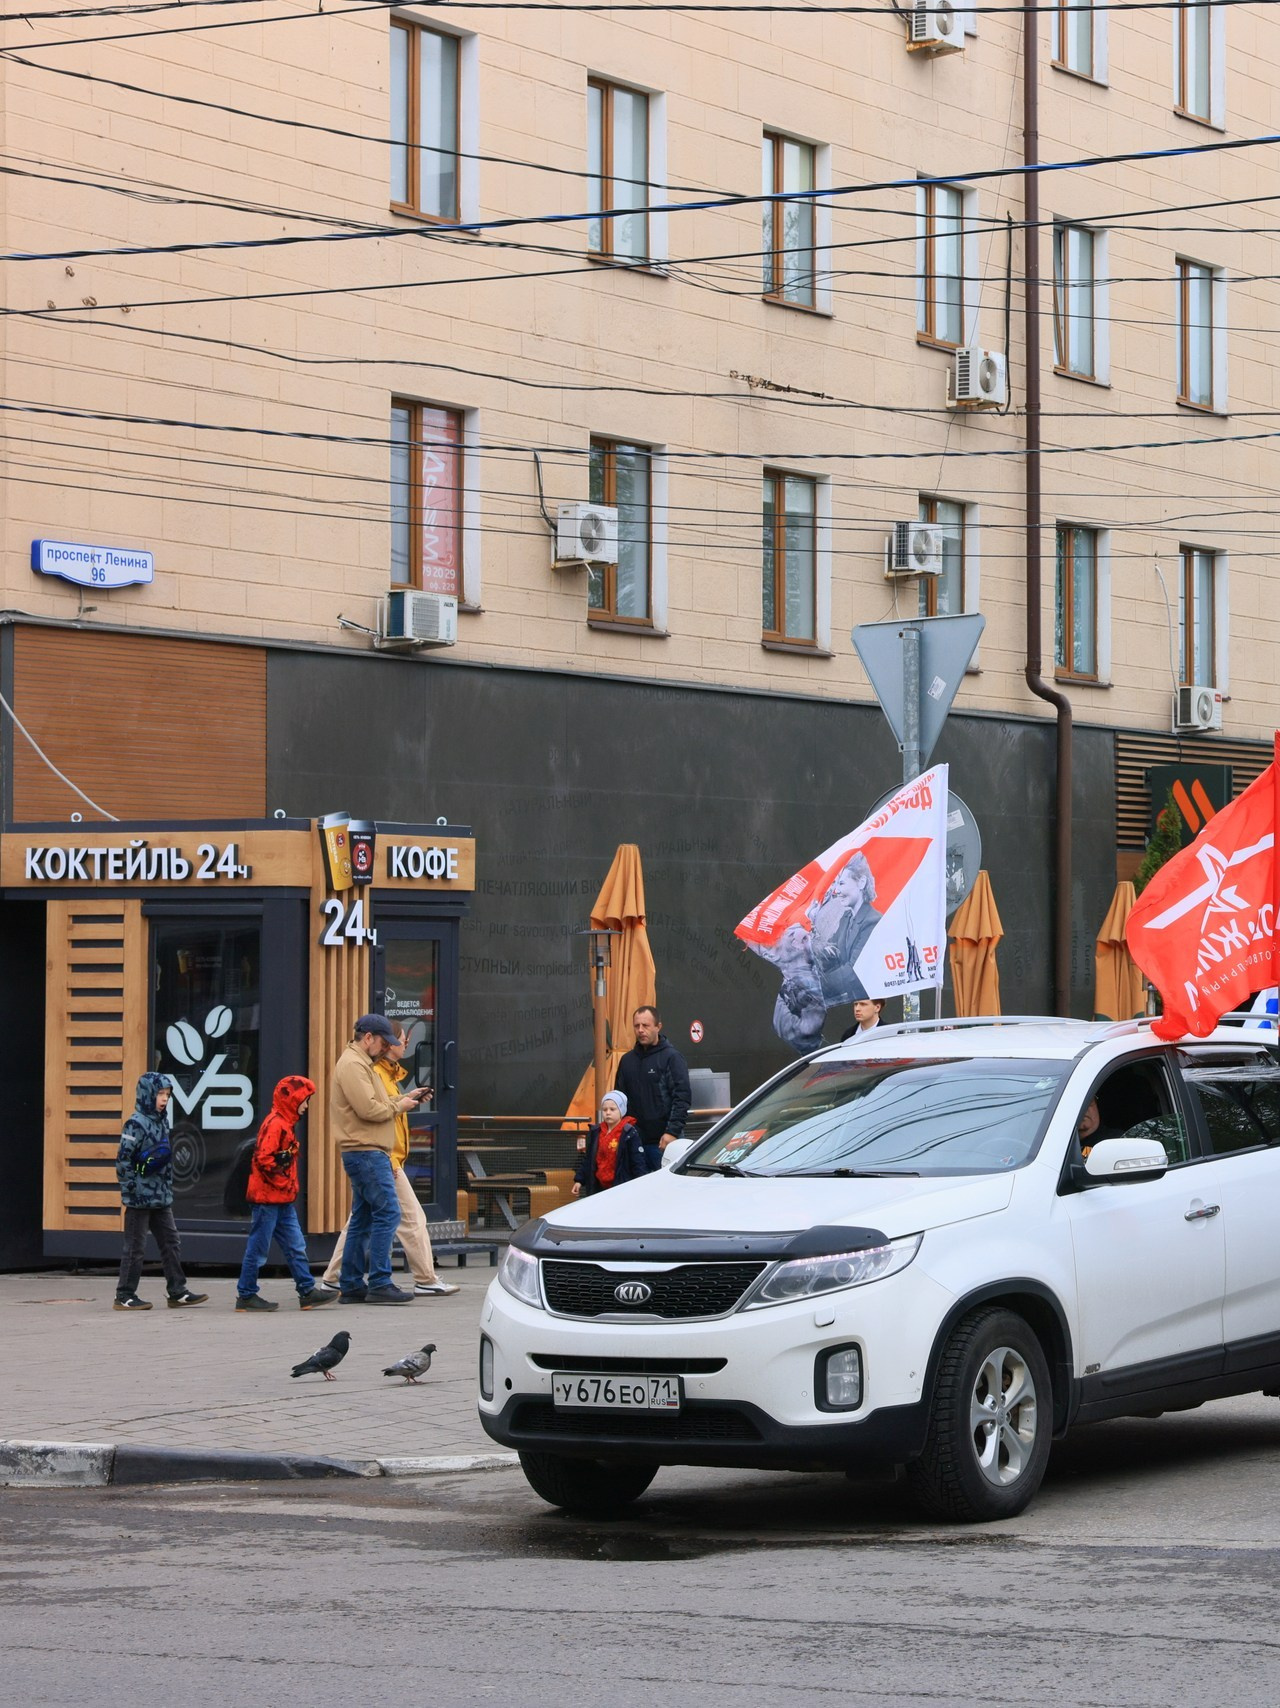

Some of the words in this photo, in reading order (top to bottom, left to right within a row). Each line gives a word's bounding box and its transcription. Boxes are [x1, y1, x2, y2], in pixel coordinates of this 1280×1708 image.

[47, 548, 102, 564] проспект
[105, 552, 148, 569] Ленина
[91, 567, 106, 582] 96
[25, 840, 190, 880] КОКТЕЙЛЬ
[196, 844, 249, 879] 24ч
[391, 846, 459, 880] КОФЕ
[324, 899, 377, 946] 24ч
[619, 1286, 644, 1300] KIA
[651, 1379, 671, 1399] 71
